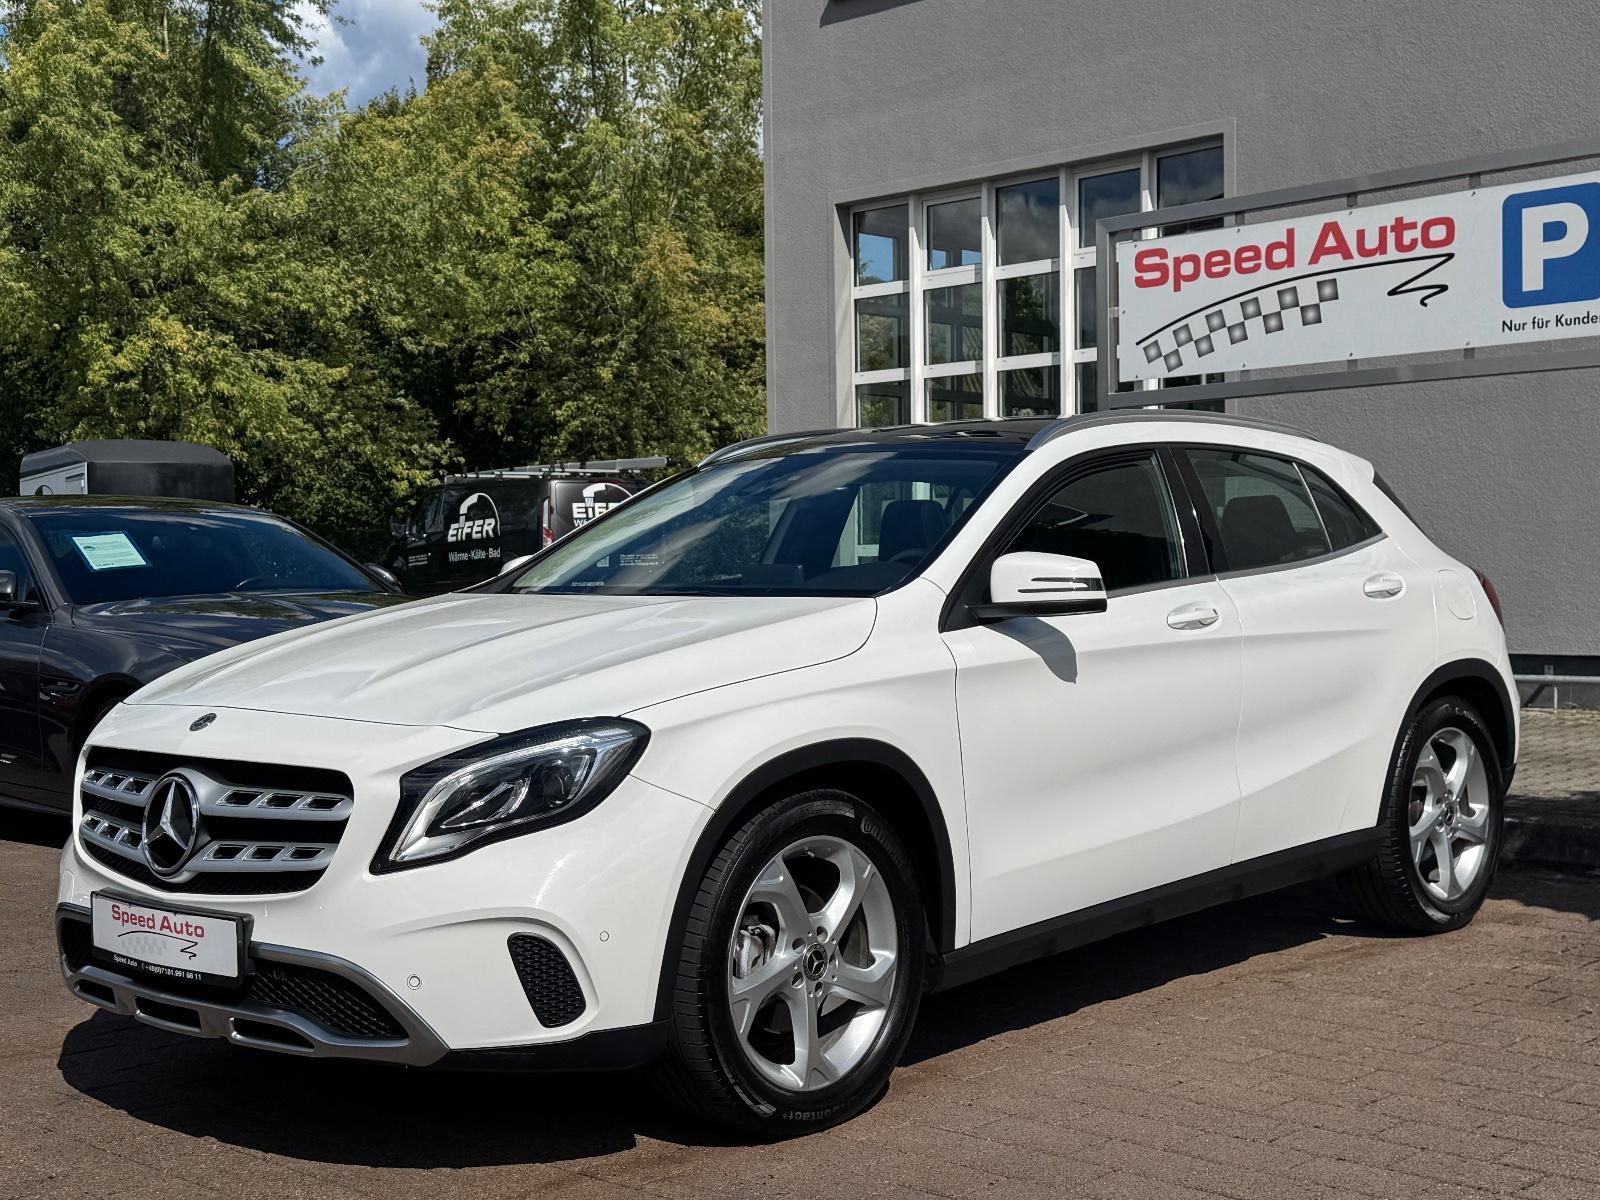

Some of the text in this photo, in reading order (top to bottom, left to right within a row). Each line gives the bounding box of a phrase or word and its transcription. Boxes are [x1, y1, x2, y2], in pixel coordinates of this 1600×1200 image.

[1133, 215, 1456, 293] Speed Auto
[1521, 201, 1590, 293] P
[1502, 310, 1600, 333] Nur für Kunde
[111, 903, 205, 938] Speed Auto
